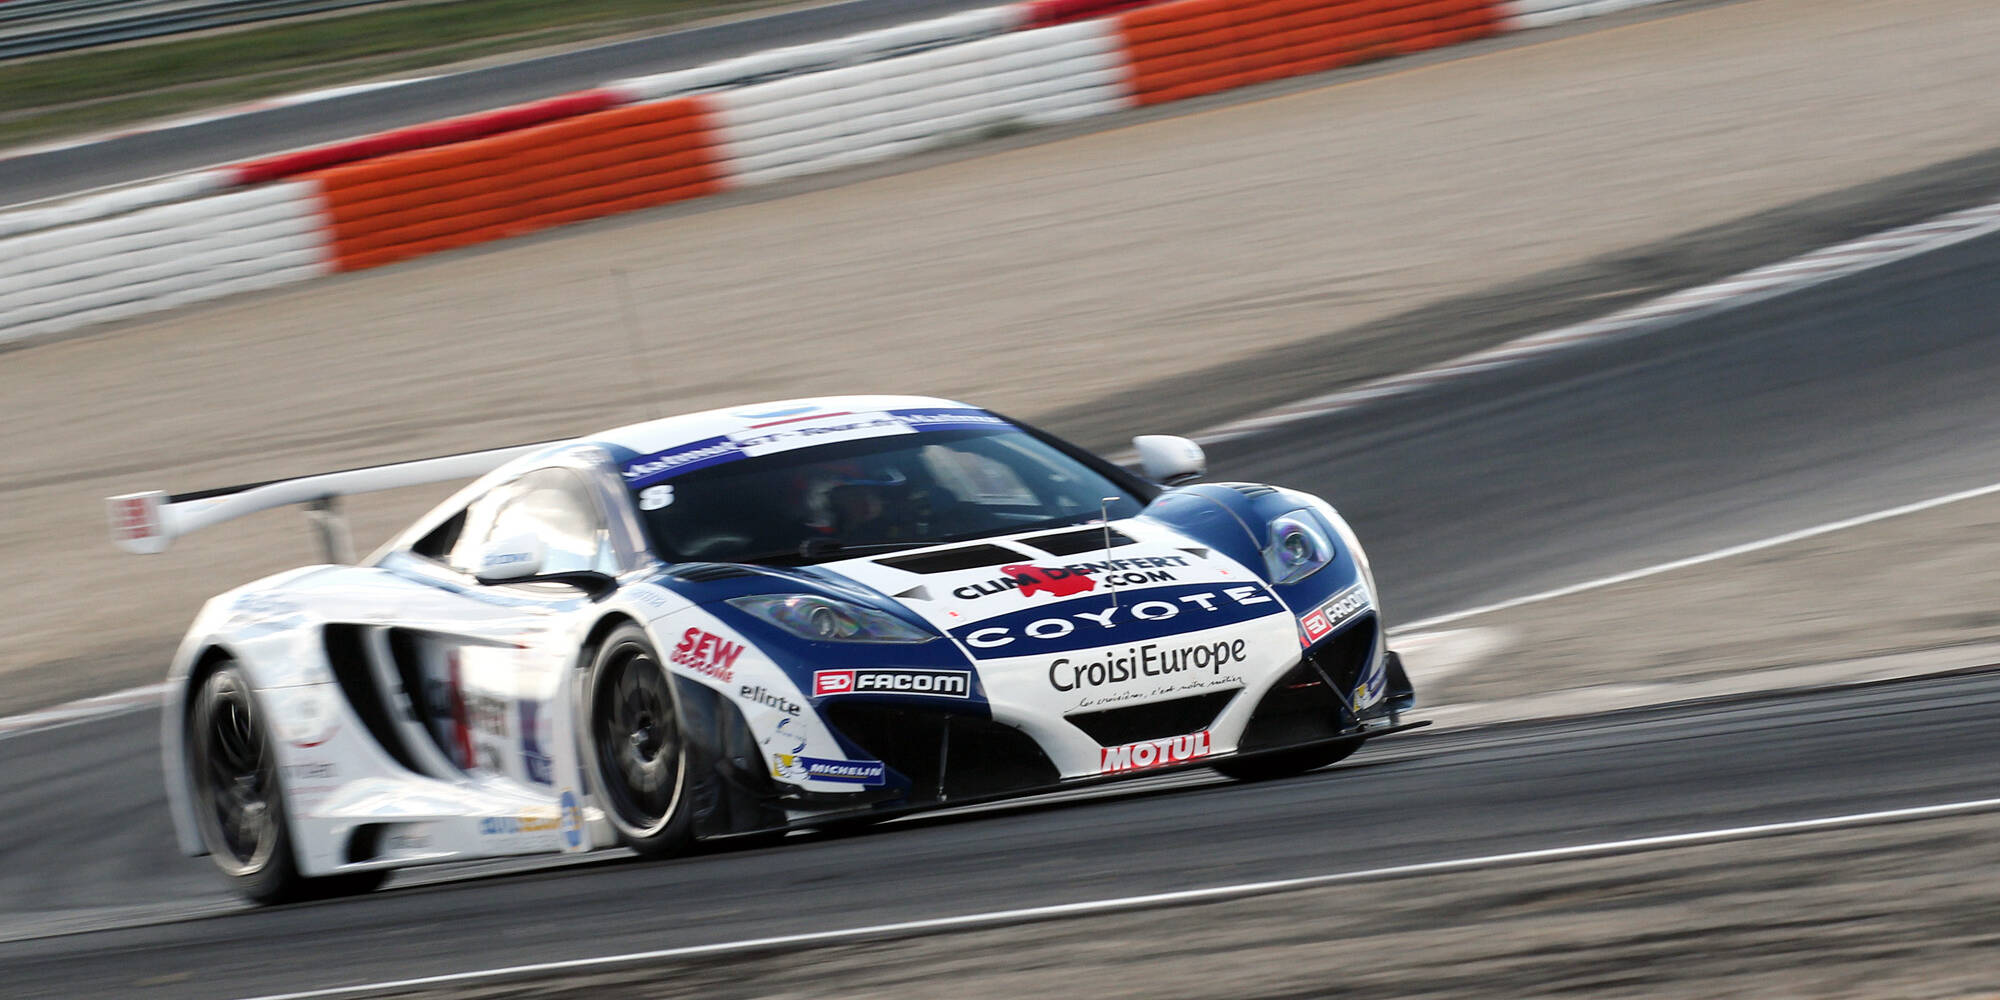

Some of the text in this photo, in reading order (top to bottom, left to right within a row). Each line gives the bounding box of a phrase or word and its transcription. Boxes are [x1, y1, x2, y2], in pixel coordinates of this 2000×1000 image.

[639, 484, 675, 511] 8
[953, 556, 1192, 600] CLIM DENFERT
[1103, 570, 1177, 588] .COM
[966, 585, 1273, 648] COYOTE
[677, 627, 746, 670] SEW
[1048, 638, 1247, 692] CroisiEurope
[856, 674, 965, 693] FACOM
[809, 763, 883, 777] MICHELIN
[1102, 732, 1209, 772] MOTUL
